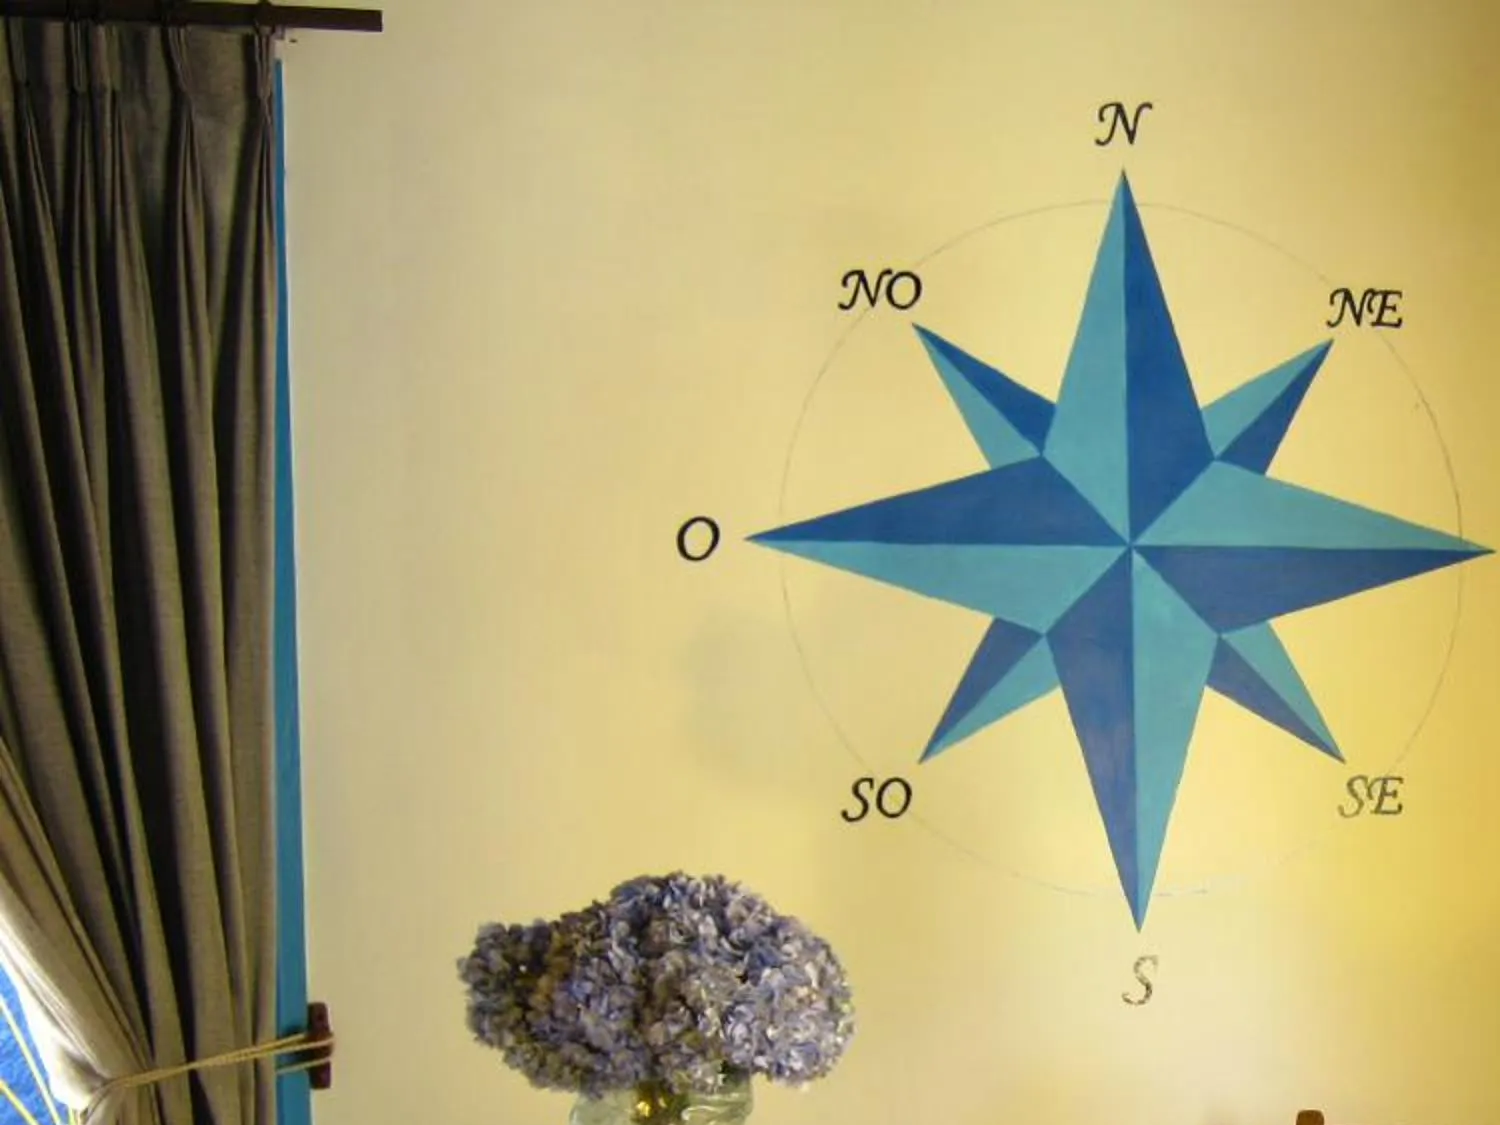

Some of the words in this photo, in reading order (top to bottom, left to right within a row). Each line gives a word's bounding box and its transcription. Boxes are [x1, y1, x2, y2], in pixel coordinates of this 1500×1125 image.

[1094, 101, 1154, 147] N
[837, 267, 922, 312] NO
[1325, 287, 1404, 330] NE
[675, 515, 721, 563] O
[839, 775, 914, 824] SO
[1337, 774, 1405, 819] SE
[1121, 955, 1159, 1007] S
